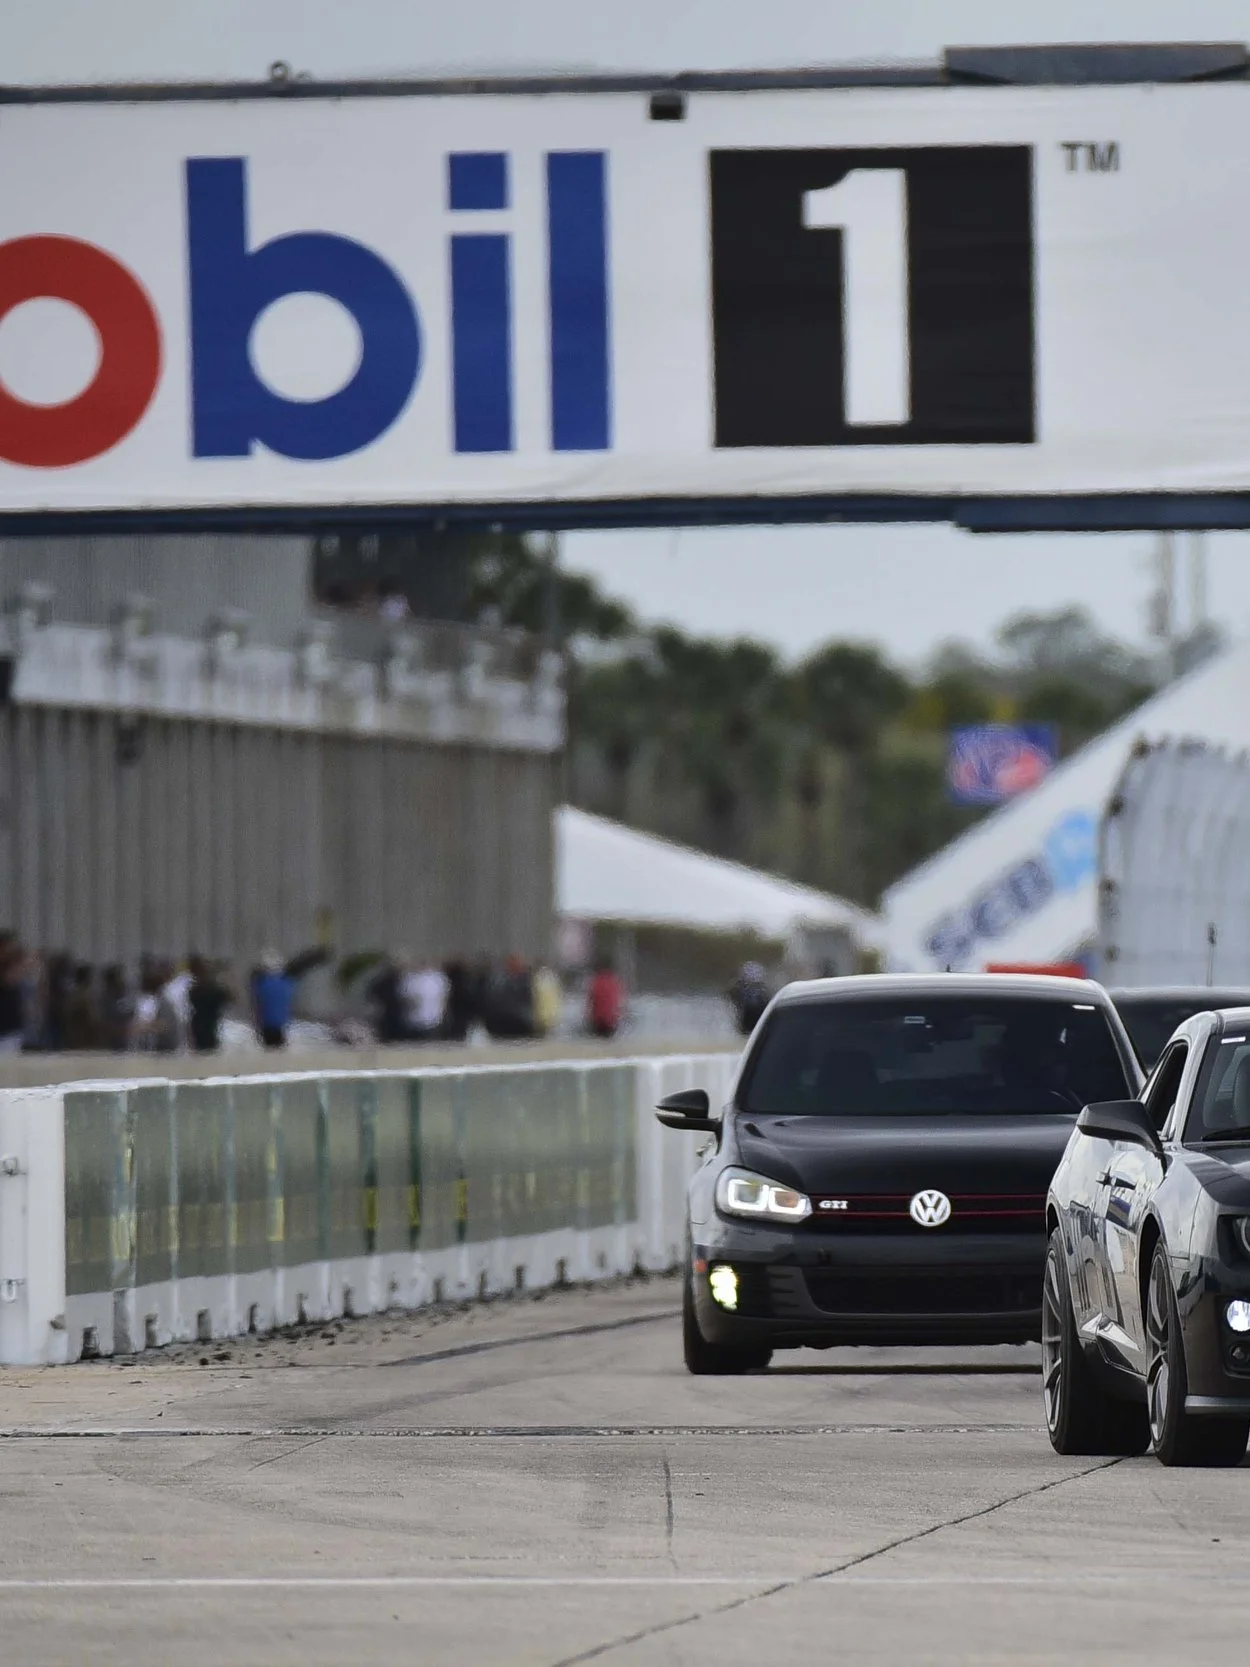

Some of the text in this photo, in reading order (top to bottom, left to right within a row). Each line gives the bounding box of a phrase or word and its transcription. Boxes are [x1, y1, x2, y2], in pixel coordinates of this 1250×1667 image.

[802, 166, 912, 428] 1
[1061, 141, 1120, 172] TM
[818, 1200, 848, 1210] GTI
